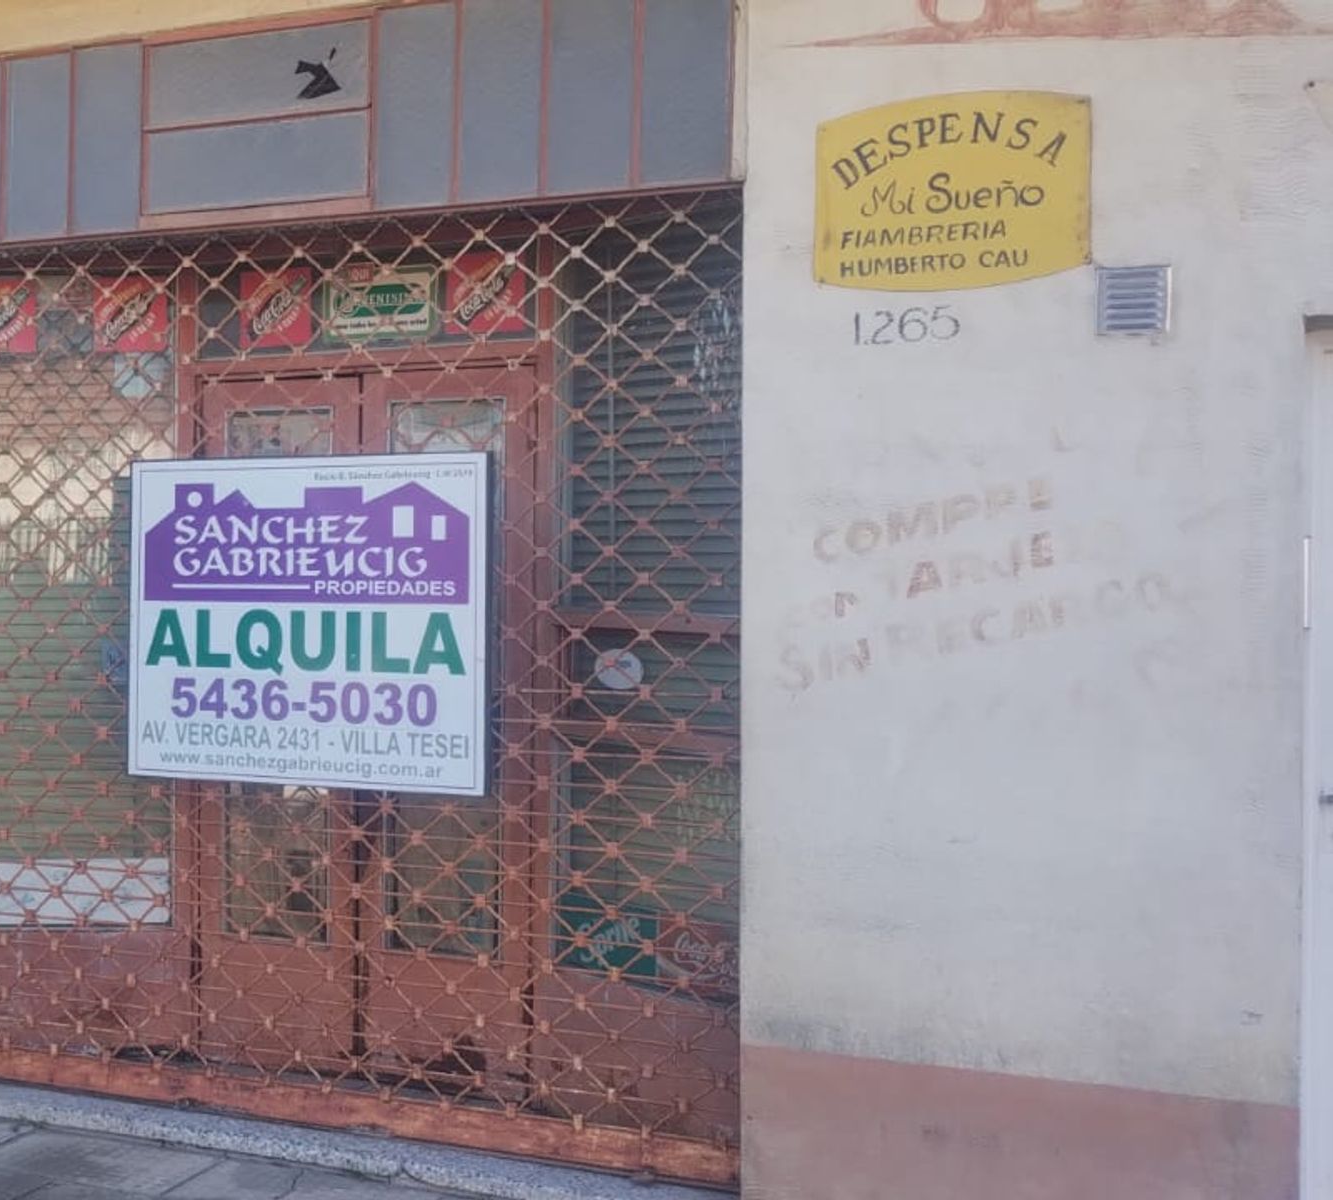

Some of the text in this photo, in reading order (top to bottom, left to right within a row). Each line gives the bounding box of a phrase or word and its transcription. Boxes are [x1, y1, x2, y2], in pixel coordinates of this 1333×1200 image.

[831, 110, 1067, 190] DESPENSA
[860, 171, 1045, 218] Mi Sueño
[840, 220, 1007, 250] FIAMBRERIA
[840, 249, 1029, 278] HUMBERTO CAU
[174, 515, 369, 545] SANCHEZ
[173, 546, 428, 578] GABRIEUCIG
[314, 579, 456, 597] PROPIEDADES
[145, 608, 466, 676] ALQUILA
[171, 677, 437, 726] 5436-5030
[142, 720, 169, 744] AV.
[176, 722, 271, 750] VERGARA
[277, 726, 320, 752] 2431
[340, 729, 401, 756] VILLA
[407, 732, 469, 760] TESEI
[159, 750, 443, 780] www.sanchezgabrieucig.com.ar
